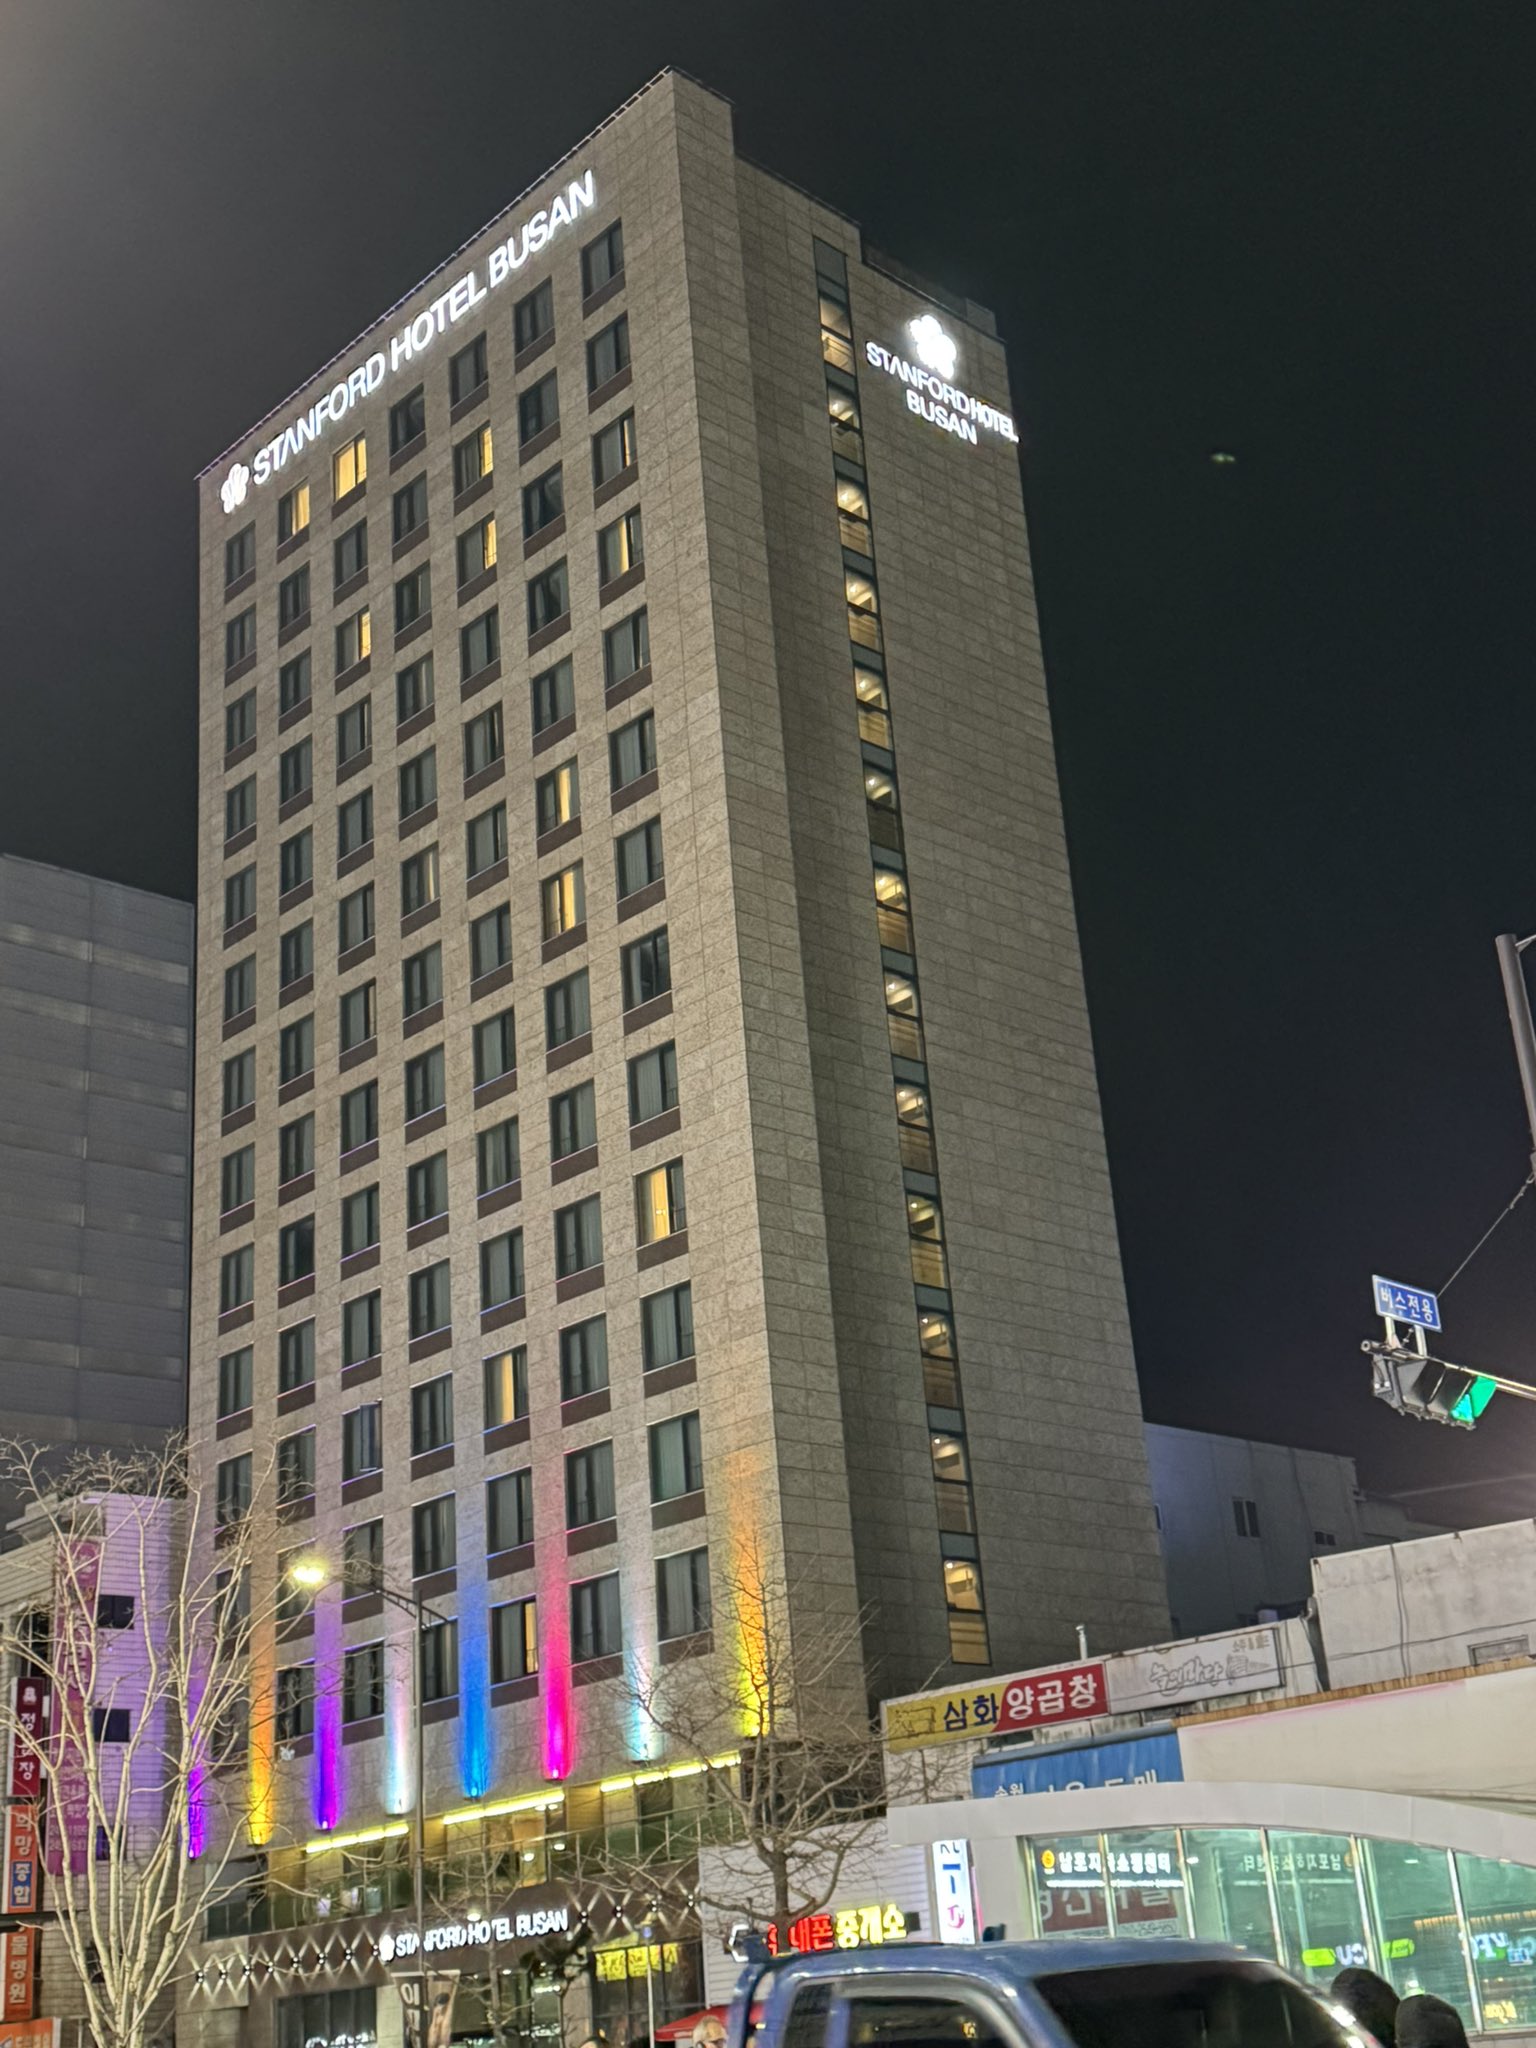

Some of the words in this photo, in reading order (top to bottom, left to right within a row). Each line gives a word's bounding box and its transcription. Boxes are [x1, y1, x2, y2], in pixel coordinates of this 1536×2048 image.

[252, 352, 386, 486] STANFORD
[390, 271, 487, 372] HOTEL
[488, 169, 595, 289] BUSAN
[866, 341, 971, 415] STANFORD
[970, 397, 1020, 443] HOTEL
[906, 389, 978, 445] BUSAN
[1380, 1286, 1434, 1323] 버스전용
[943, 1693, 999, 1732] 삼화
[1006, 1673, 1098, 1720] 양곱창
